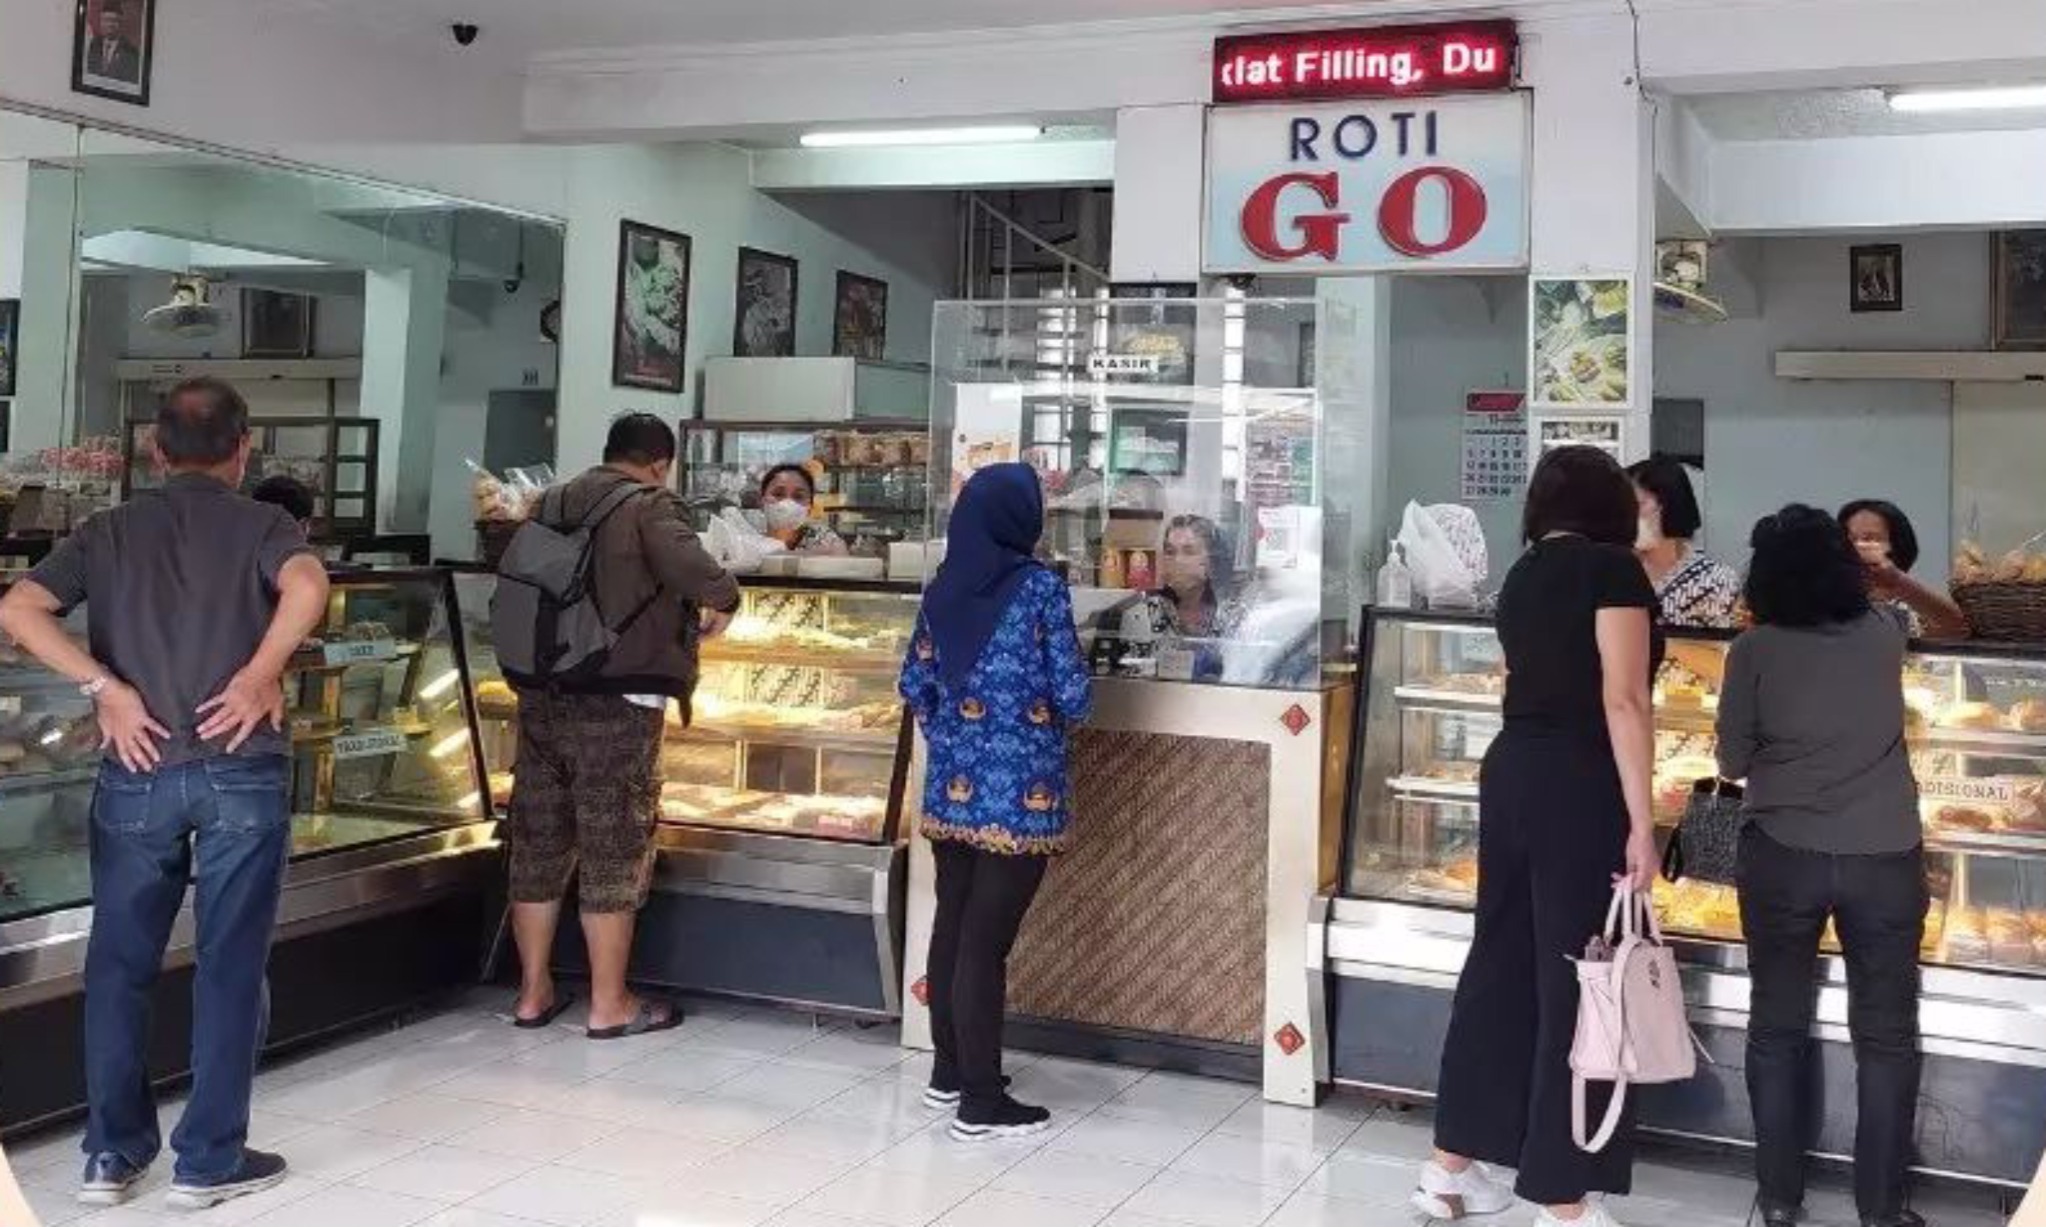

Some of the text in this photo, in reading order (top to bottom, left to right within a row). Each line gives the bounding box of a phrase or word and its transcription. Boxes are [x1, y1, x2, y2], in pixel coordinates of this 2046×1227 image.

[1296, 48, 1424, 85] Filling,
[1442, 42, 1496, 74] Du
[1290, 110, 1438, 161] ROTI
[1240, 165, 1488, 262] GO
[1092, 358, 1151, 369] KASIR
